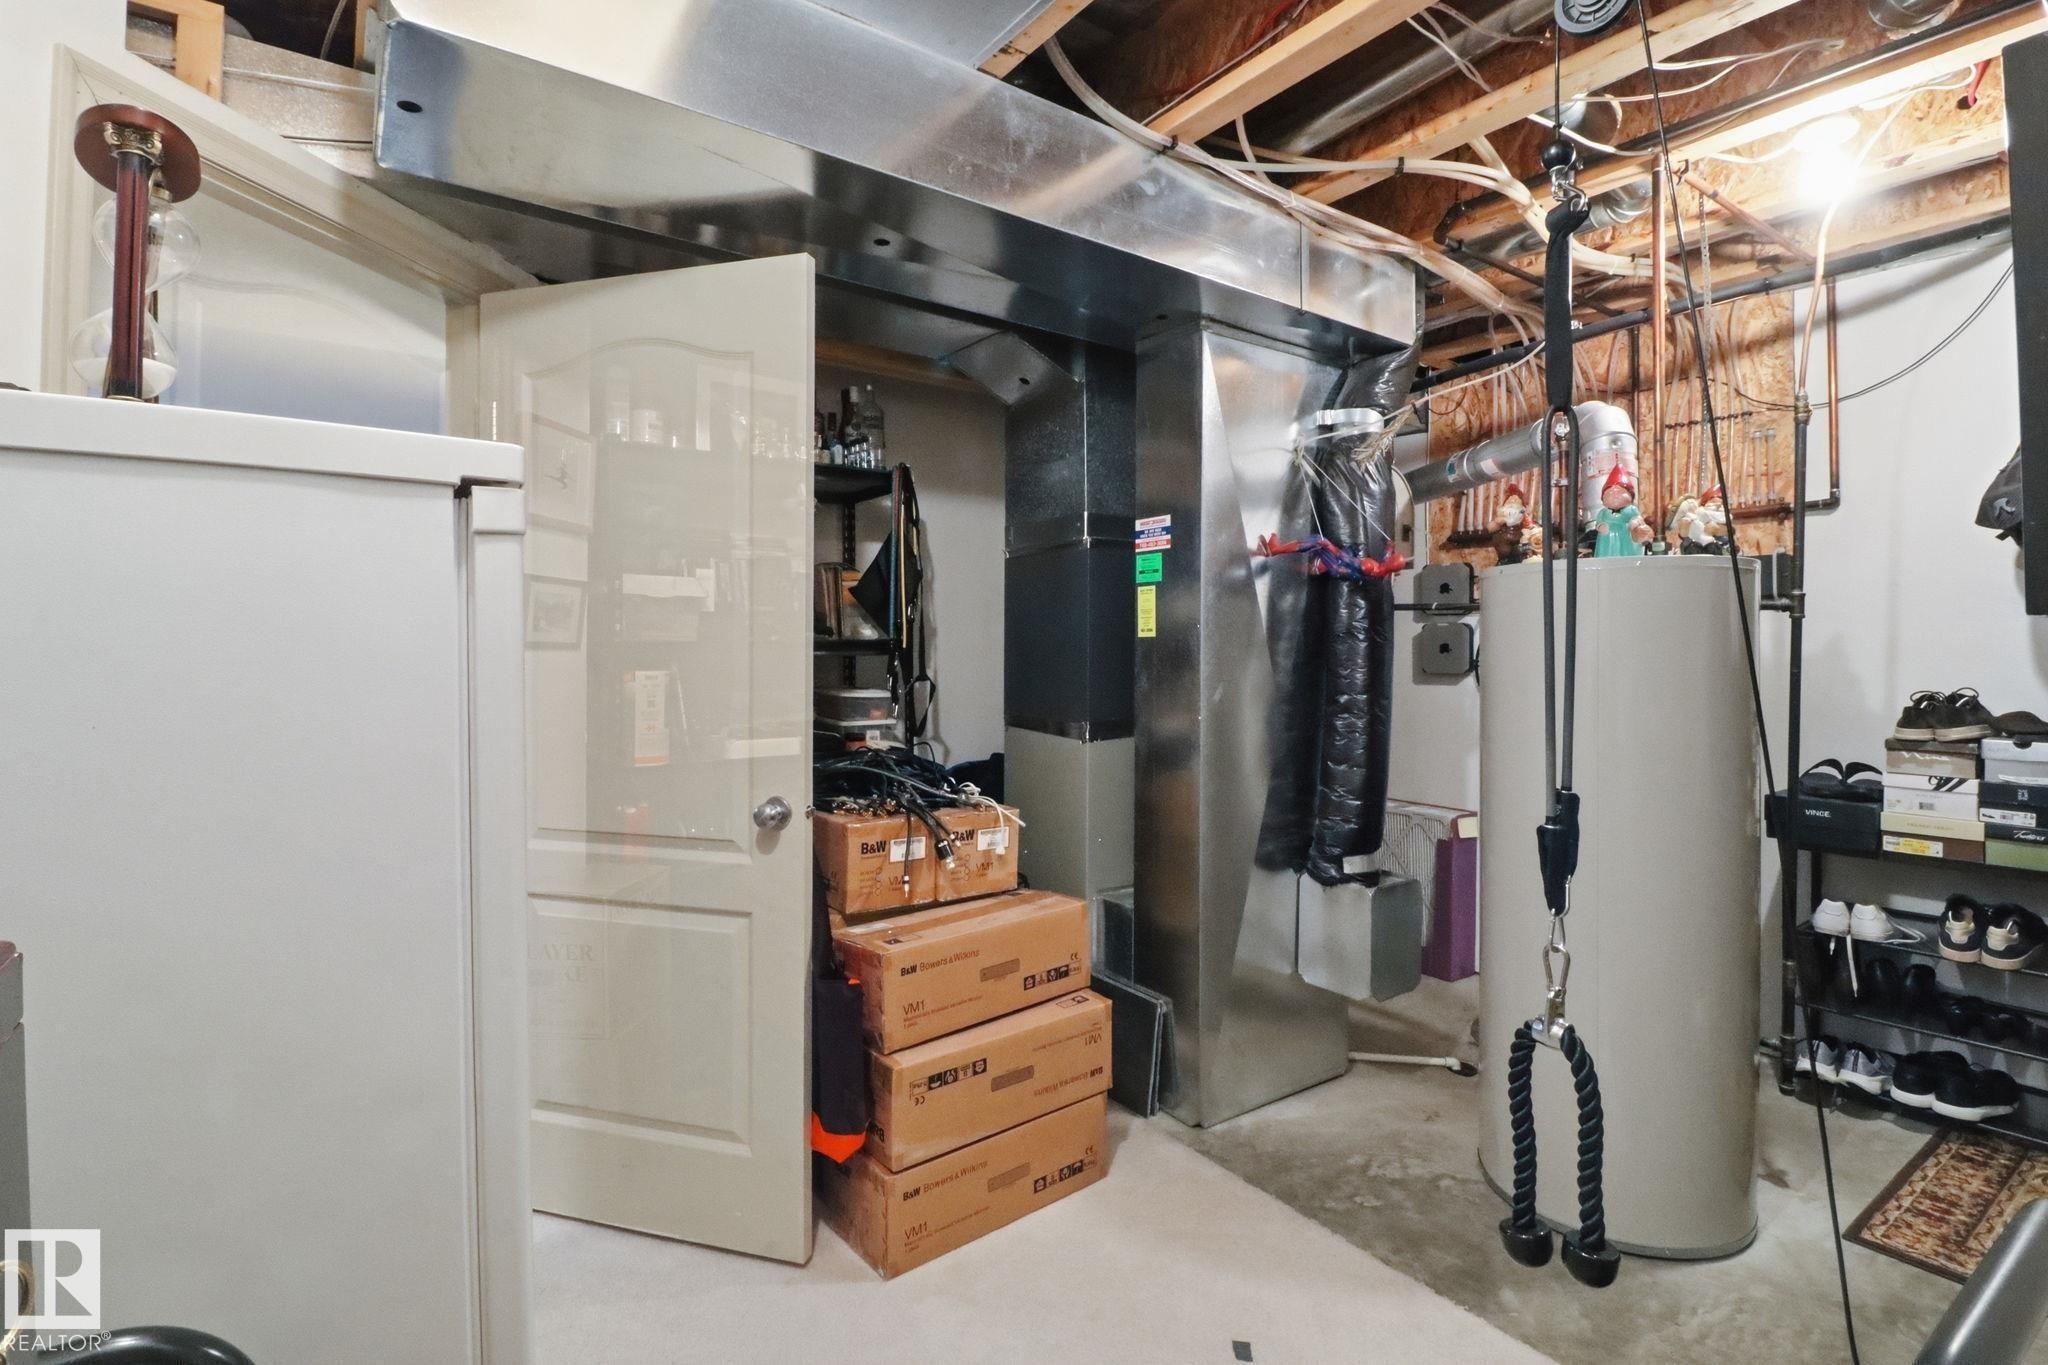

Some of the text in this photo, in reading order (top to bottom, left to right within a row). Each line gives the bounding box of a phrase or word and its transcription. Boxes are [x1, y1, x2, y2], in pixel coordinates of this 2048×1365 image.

[861, 840, 887, 855] B&W
[900, 964, 918, 977] B&W
[919, 957, 948, 972] Bowers
[902, 999, 926, 1016] VM1
[902, 1186, 922, 1201] B&W
[923, 1173, 954, 1193] Bowers
[904, 1220, 928, 1240] VM1
